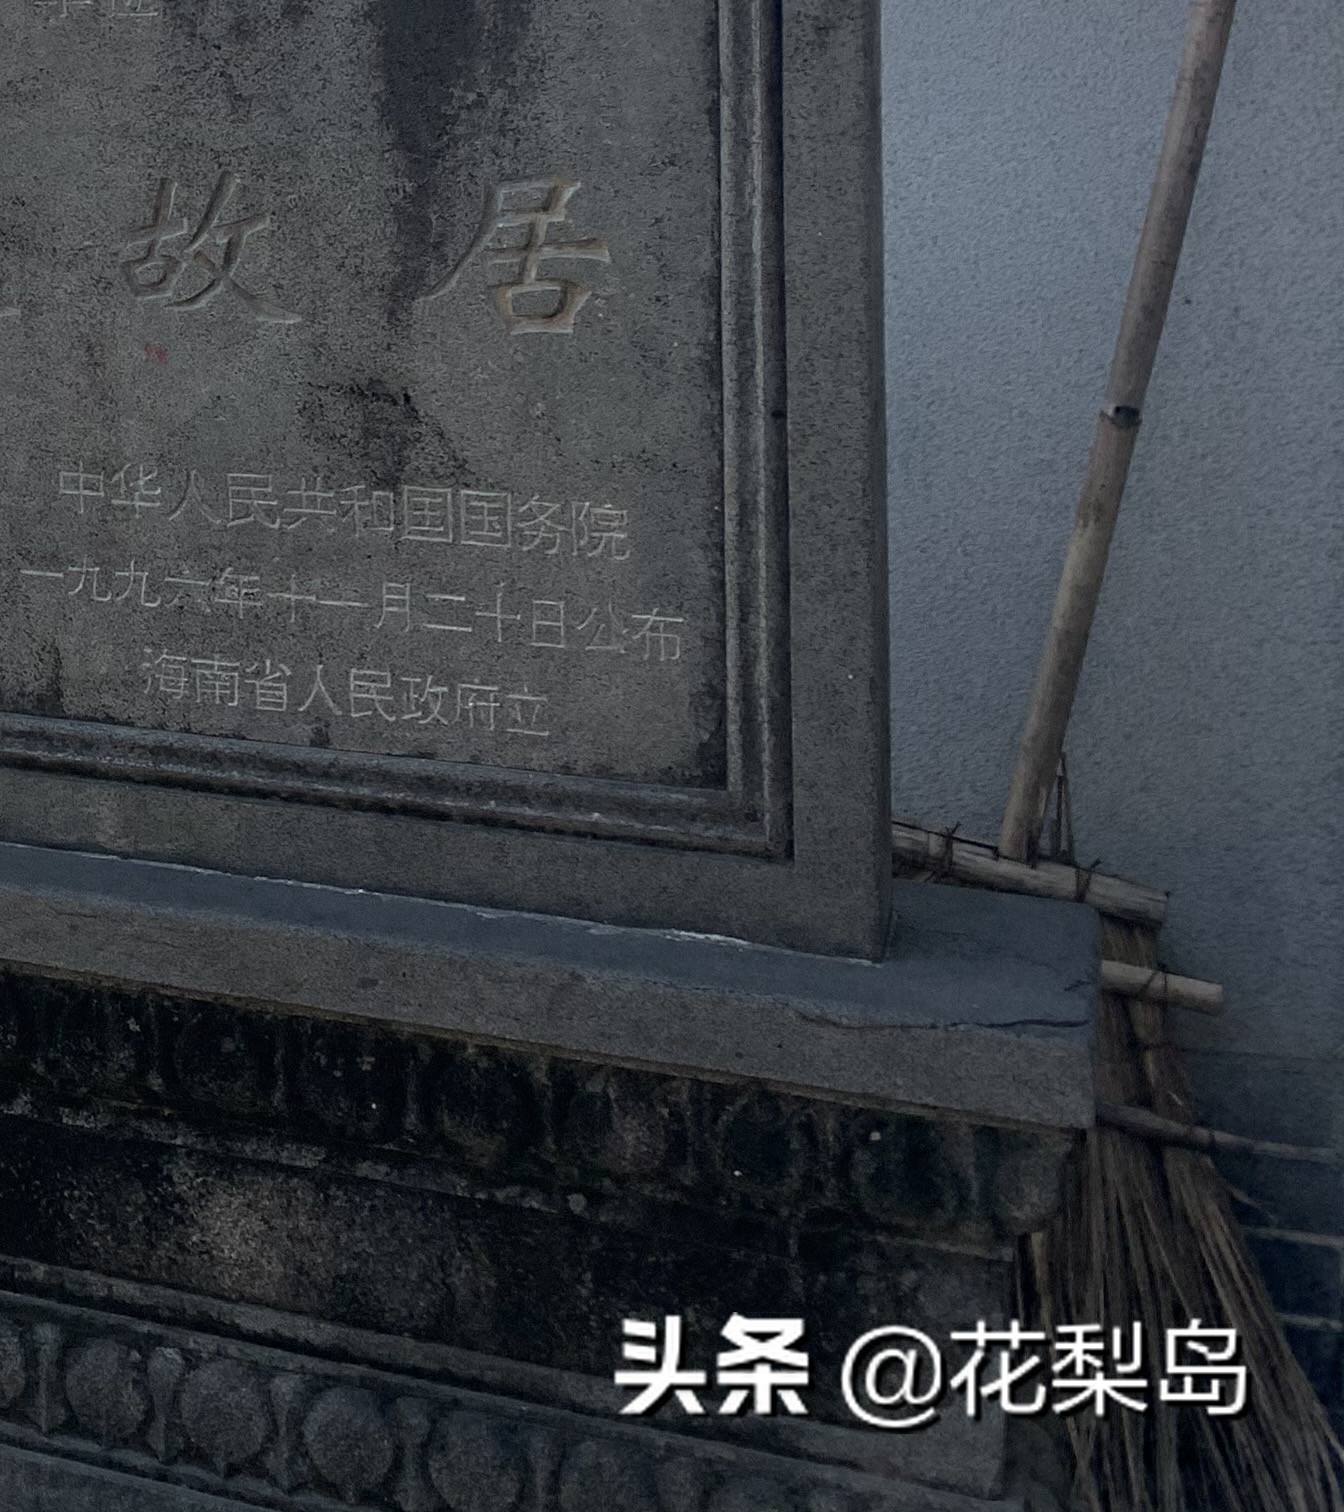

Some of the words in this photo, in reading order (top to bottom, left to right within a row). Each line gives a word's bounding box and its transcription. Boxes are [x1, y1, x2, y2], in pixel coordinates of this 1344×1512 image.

[58, 463, 631, 560] 中华人民共和国国务院
[20, 556, 684, 662] 一九九六年十一月二十日公布
[141, 648, 550, 737] 海南省人民政府立
